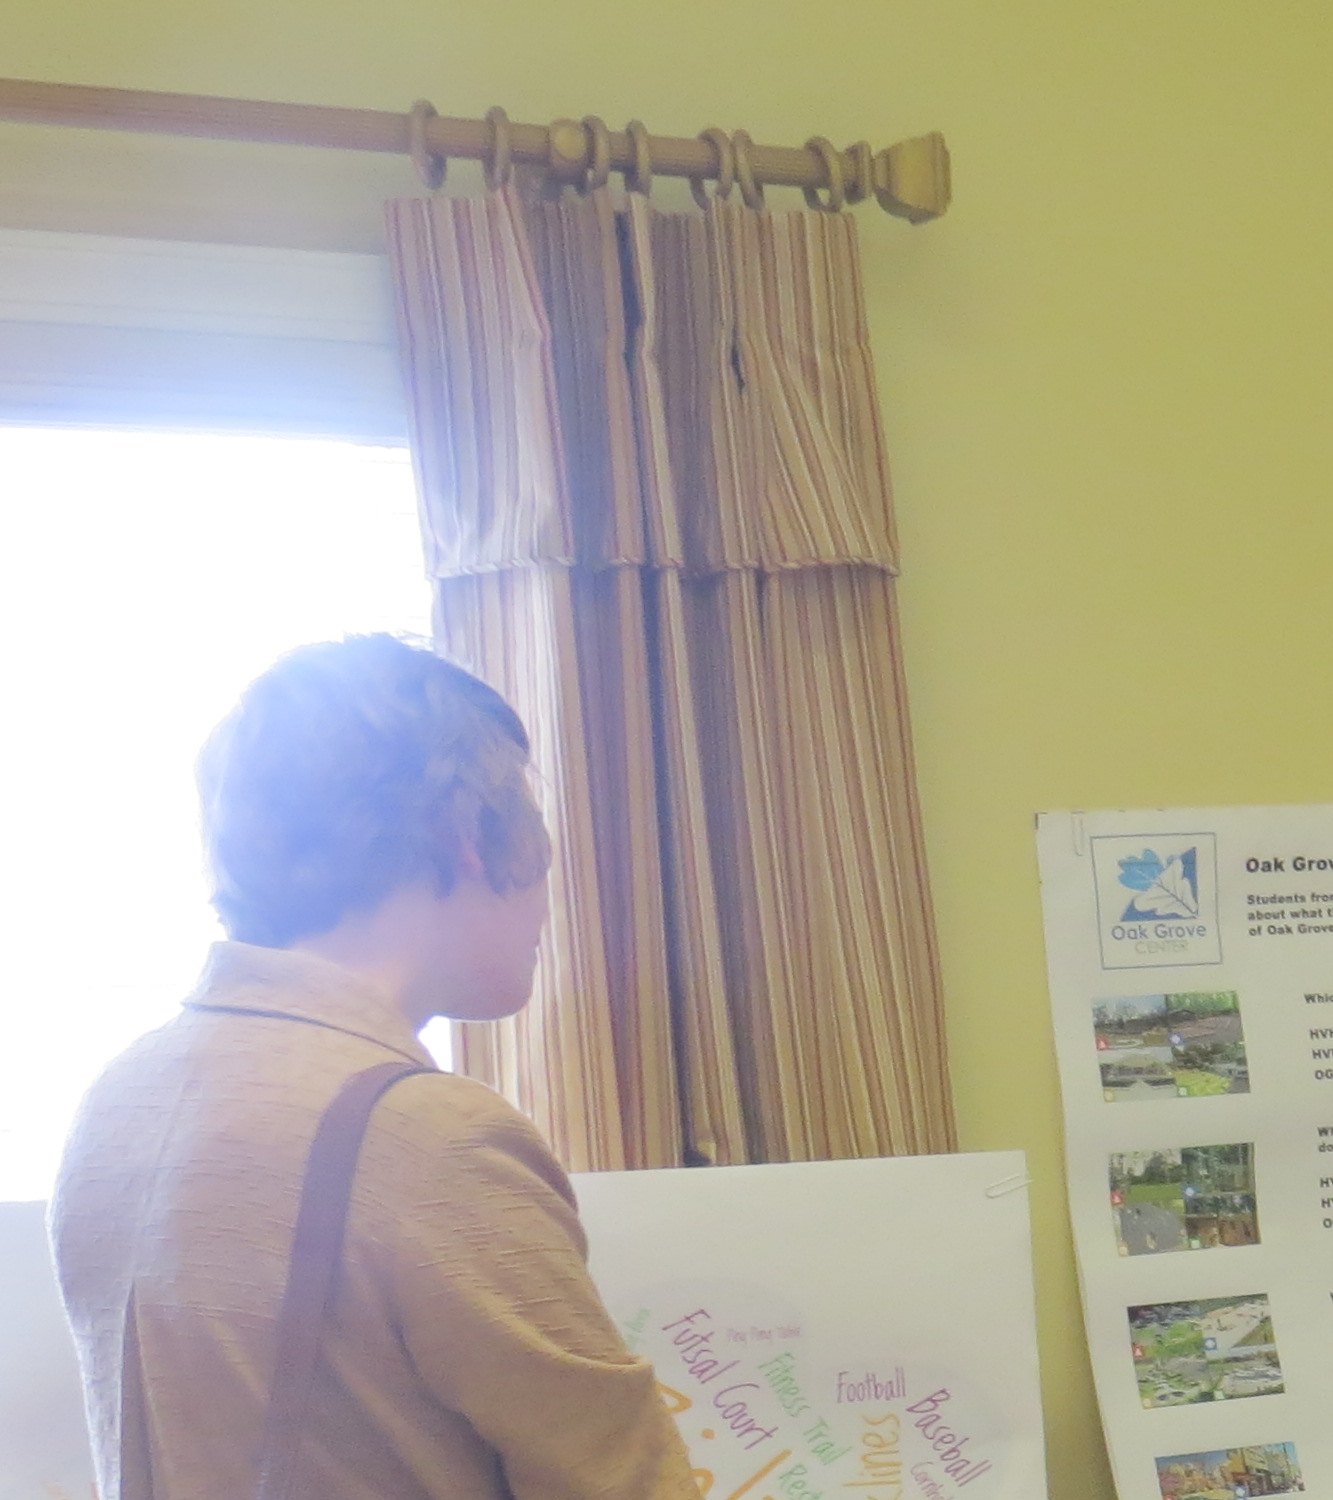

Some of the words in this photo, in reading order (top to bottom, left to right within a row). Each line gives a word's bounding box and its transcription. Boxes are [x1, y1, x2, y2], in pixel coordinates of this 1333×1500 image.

[1246, 857, 1284, 873] Oak
[1247, 894, 1306, 905] Students
[1248, 910, 1285, 920] about
[1290, 908, 1323, 919] what
[1112, 925, 1147, 940] Oak
[1155, 923, 1207, 939] Grove
[1249, 925, 1262, 936] of
[1267, 924, 1293, 935] Oak
[1135, 940, 1189, 954] CENTER
[1319, 1143, 1333, 1152] do
[662, 1309, 740, 1384] Futsal
[713, 1383, 779, 1450] Court
[837, 1367, 906, 1404] Football
[758, 1352, 811, 1418] Fitness
[803, 1416, 853, 1465] Trail
[906, 1388, 993, 1487] Baseball
